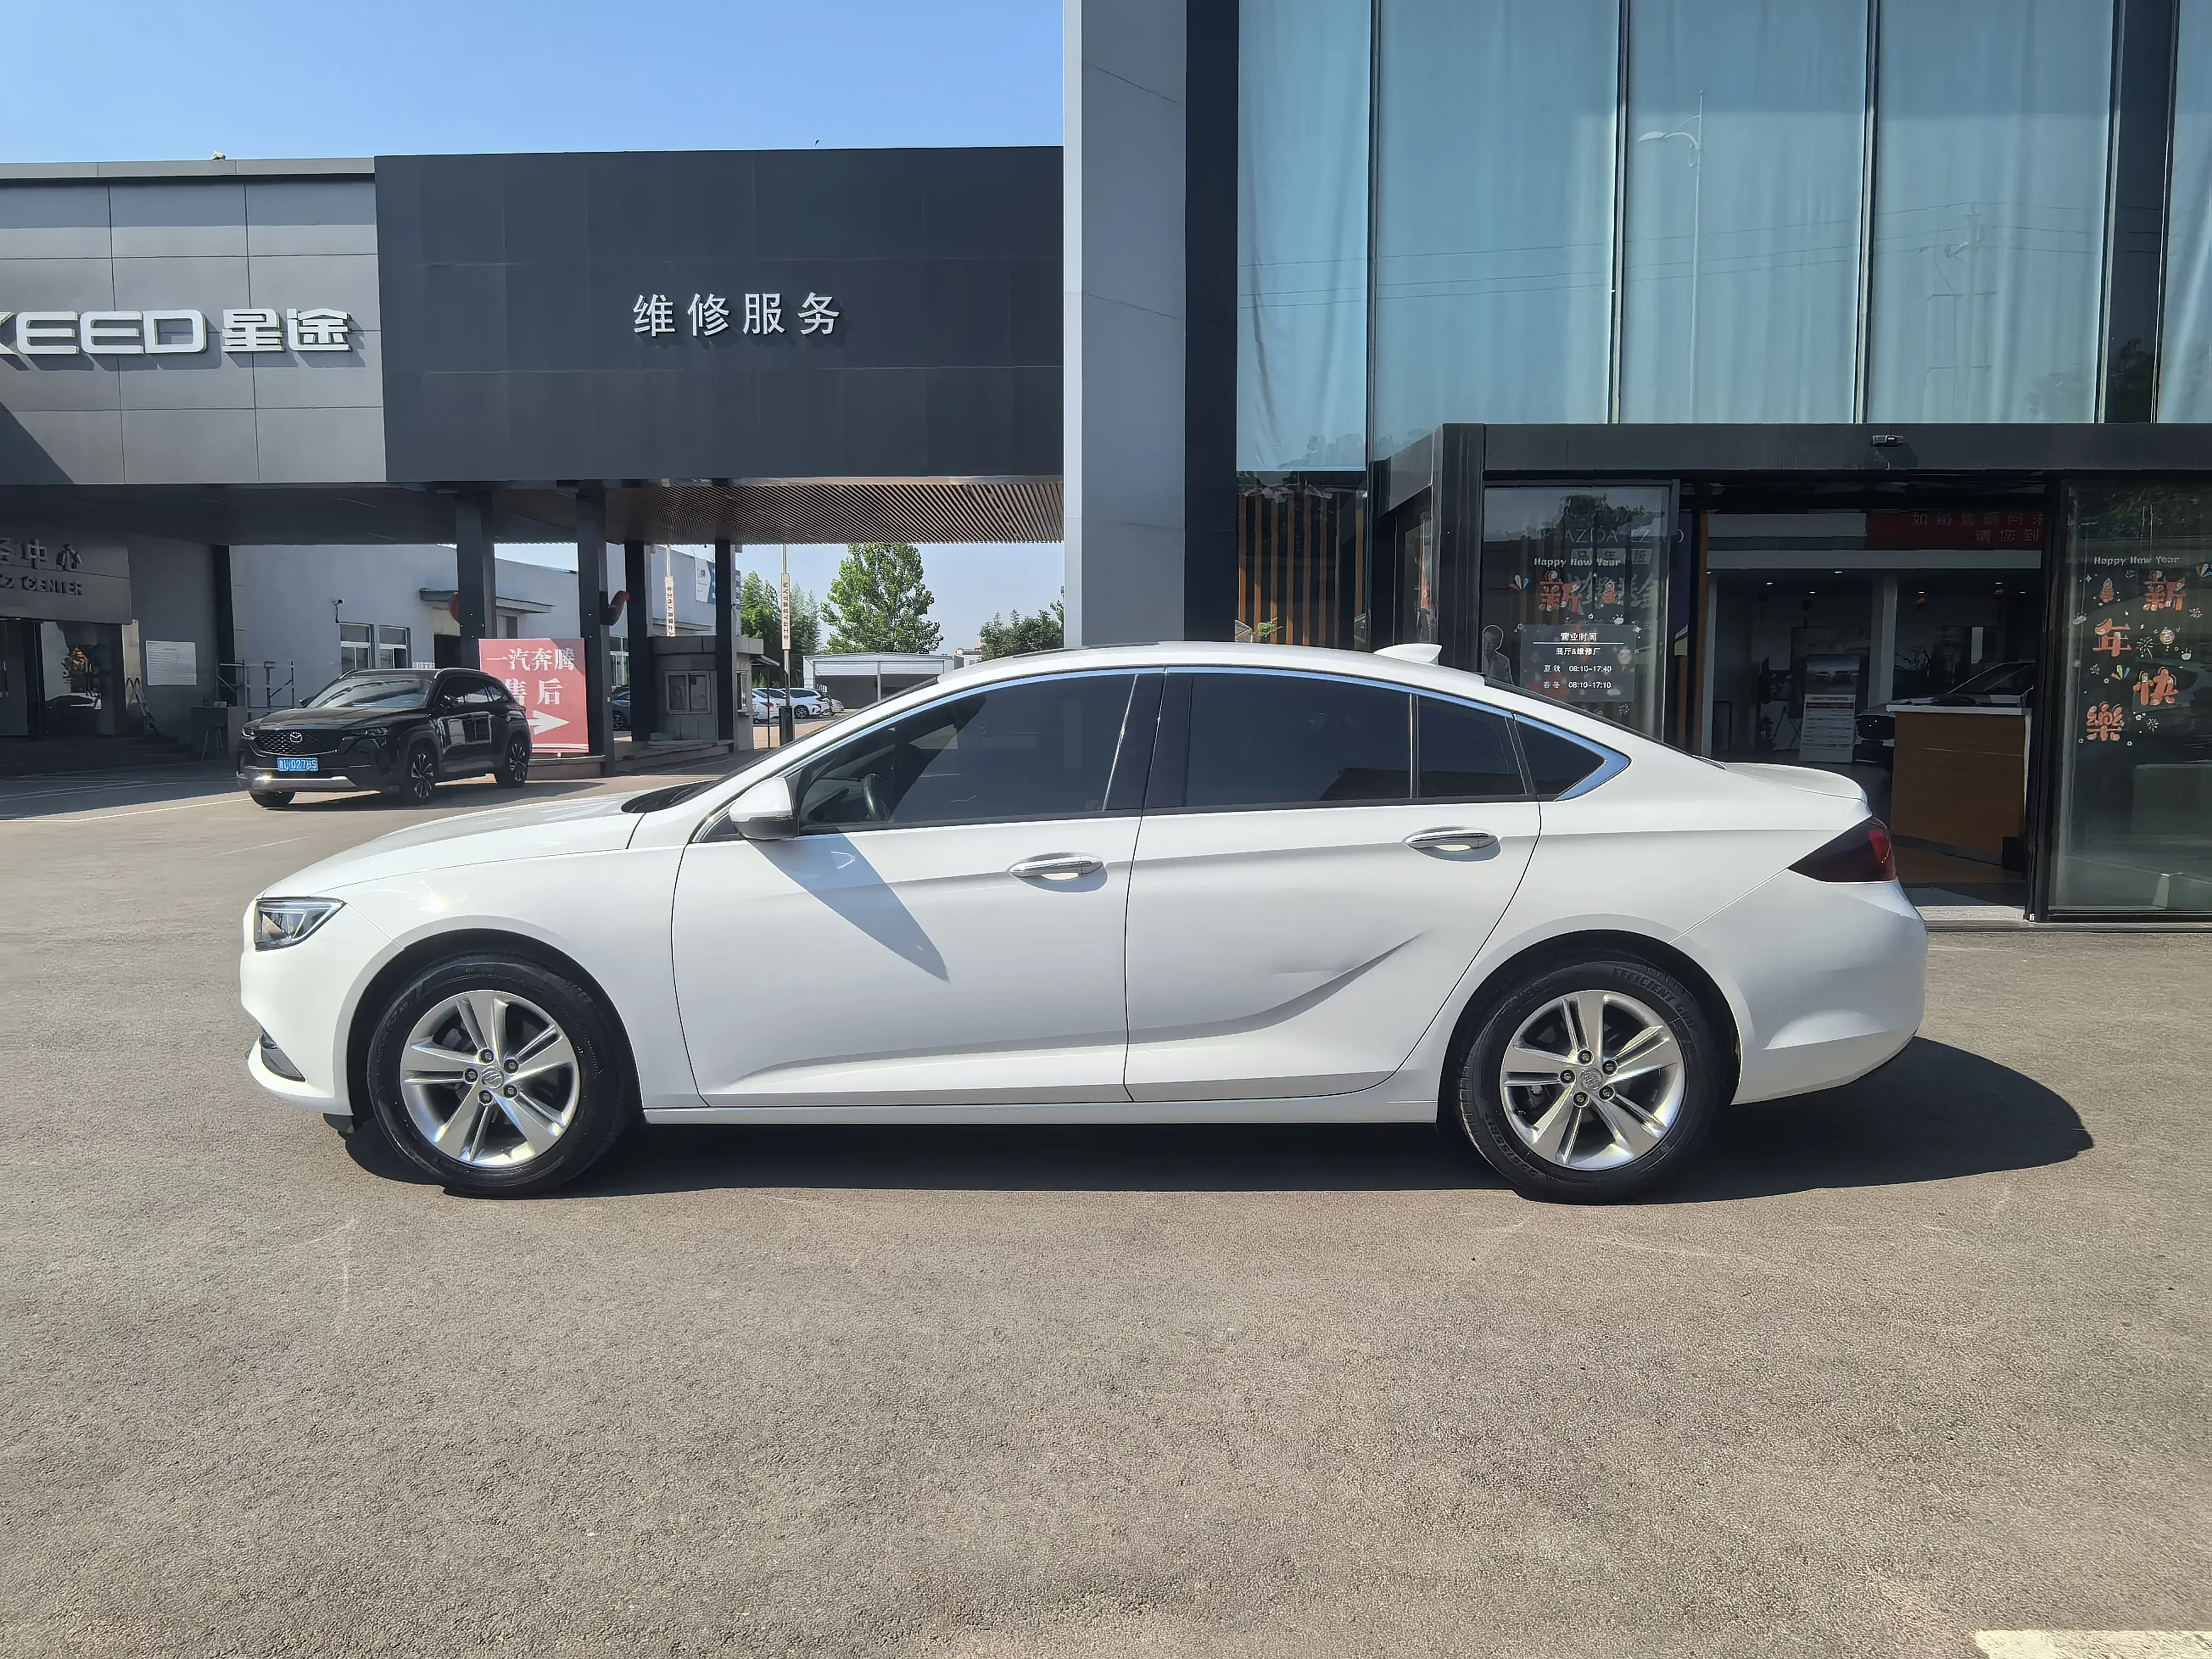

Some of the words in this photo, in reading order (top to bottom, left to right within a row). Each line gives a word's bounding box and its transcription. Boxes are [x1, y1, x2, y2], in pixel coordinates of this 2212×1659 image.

[633, 292, 840, 337] 维修服务
[222, 308, 351, 352] 星途
[1534, 557, 1566, 568] Happy
[2094, 556, 2126, 566] Happy
[1560, 632, 1597, 642] 营业时间
[487, 648, 575, 671] 一汽奔腾
[504, 677, 564, 706] 售后
